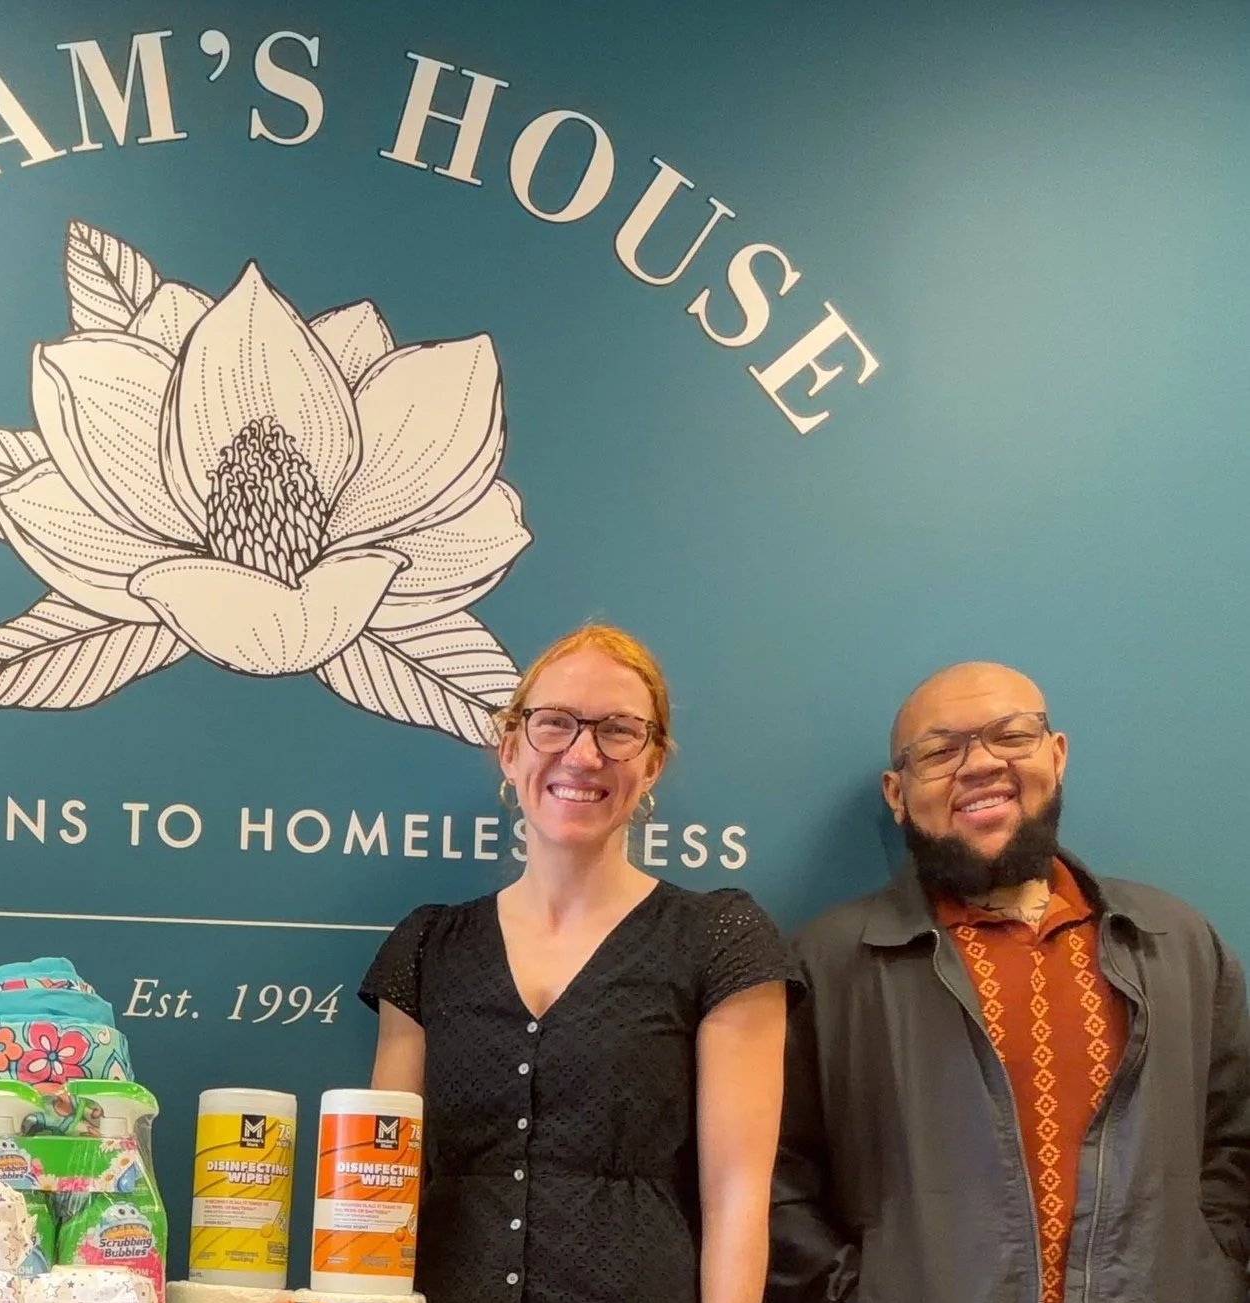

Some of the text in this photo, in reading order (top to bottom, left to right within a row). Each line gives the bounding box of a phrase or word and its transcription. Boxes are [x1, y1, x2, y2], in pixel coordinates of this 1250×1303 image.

[378, 51, 880, 436] HOUSE
[122, 802, 203, 849] TO
[240, 806, 747, 870] HOMELESESS
[123, 977, 343, 1024] Est. 1994
[206, 1160, 290, 1177] DISINFECTING
[227, 1172, 272, 1186] WIPES
[360, 1174, 405, 1188] WIPES
[99, 1237, 153, 1249] Scrubbing
[104, 1247, 147, 1258] Bubbles
